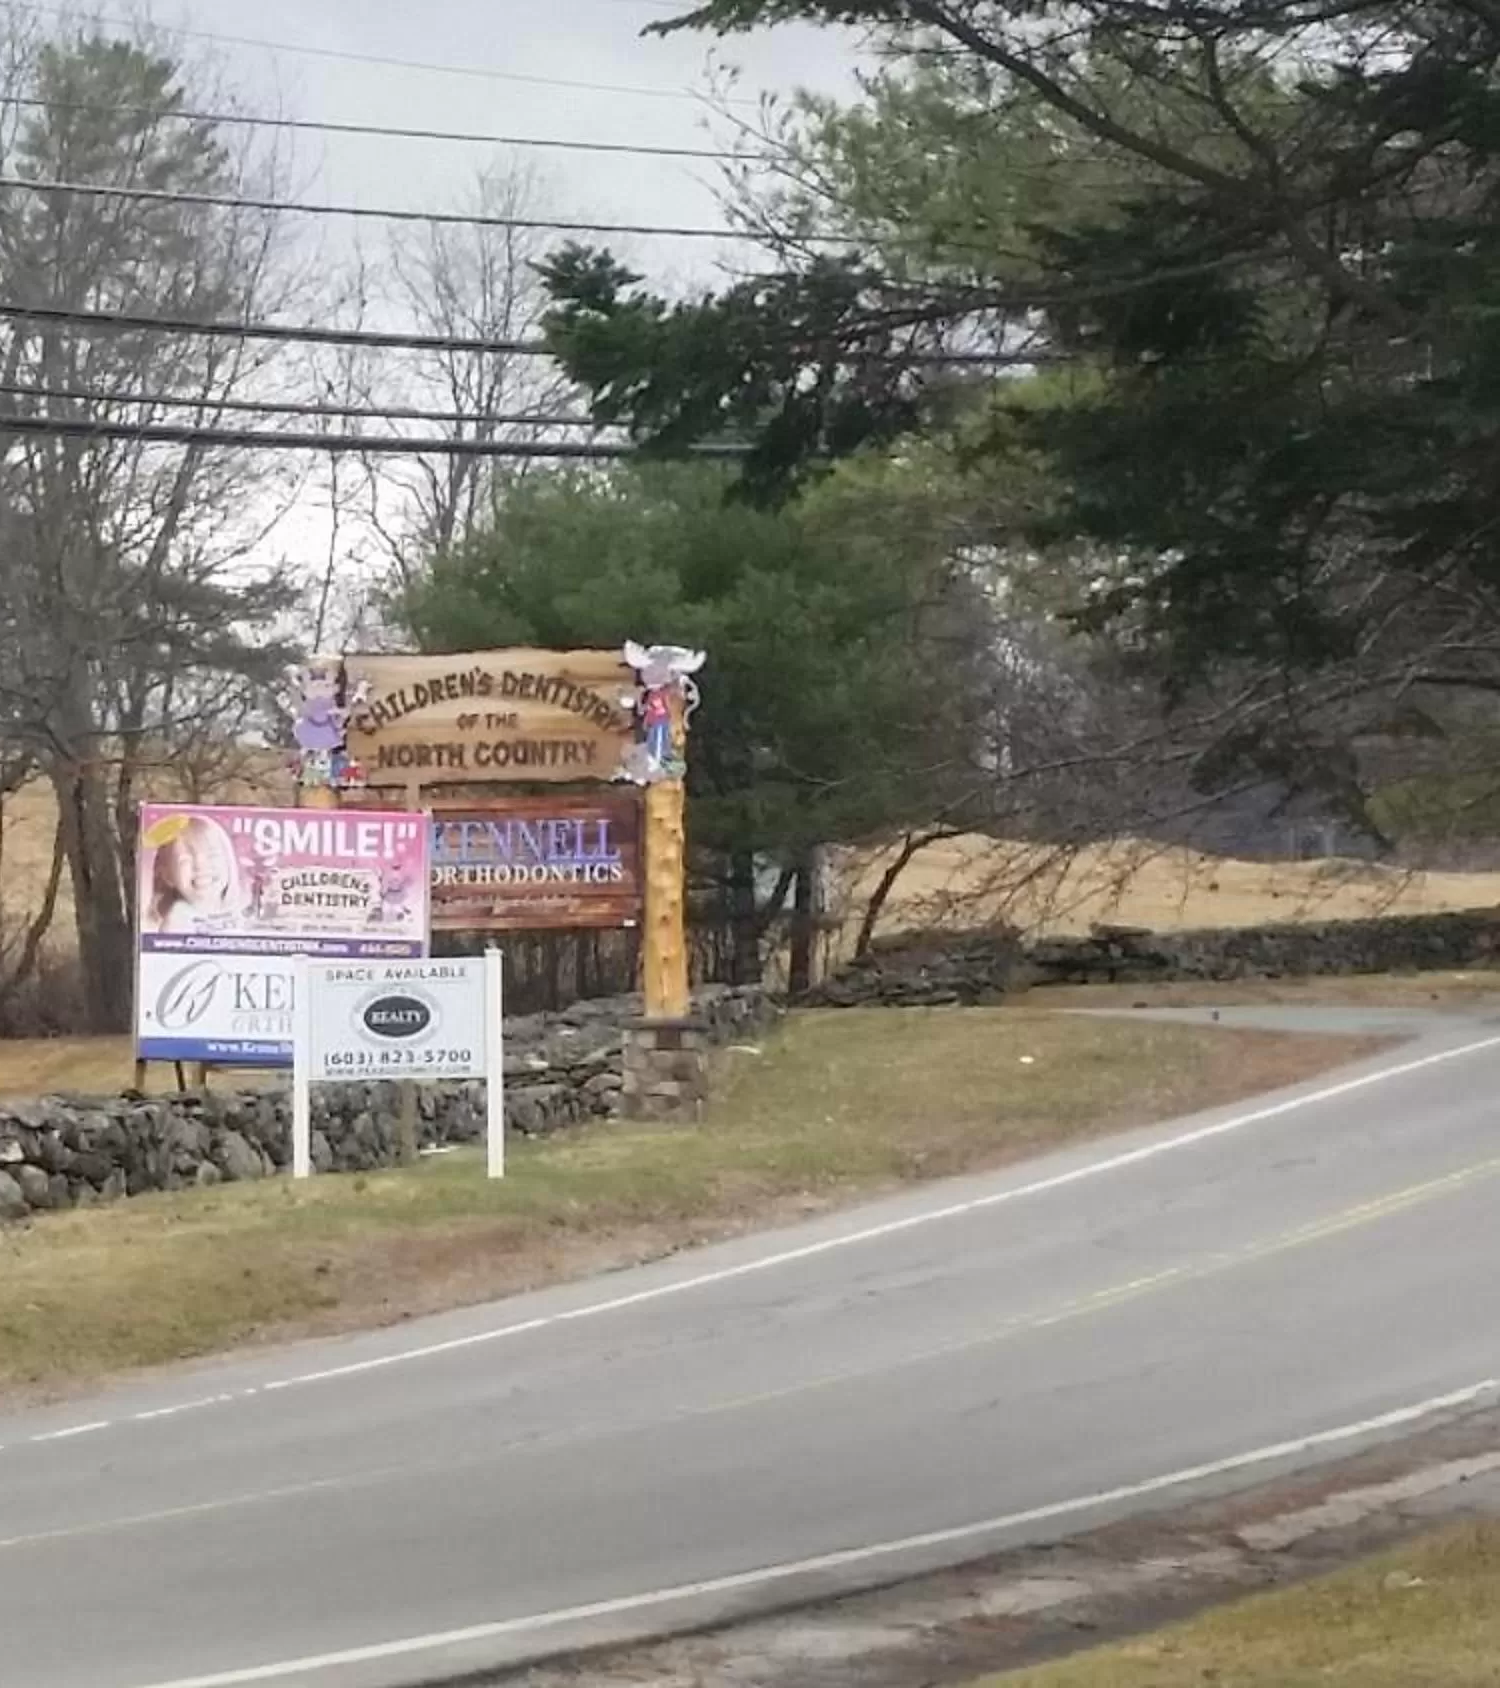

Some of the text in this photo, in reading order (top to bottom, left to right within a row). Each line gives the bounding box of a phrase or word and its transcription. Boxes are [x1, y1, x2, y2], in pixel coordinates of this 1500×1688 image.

[356, 666, 622, 735] CHILDREN'S DENTISTRY
[456, 713, 518, 730] OF THE
[377, 740, 598, 768] NORTH COUNTRY
[430, 818, 621, 864] KENNELL
[431, 863, 624, 886] ORTHODONTICS
[280, 894, 371, 908] DENTISTRY
[326, 966, 466, 981] SPACE AVAILABLE
[370, 1009, 422, 1025] REALTY
[323, 1051, 374, 1067] (603)
